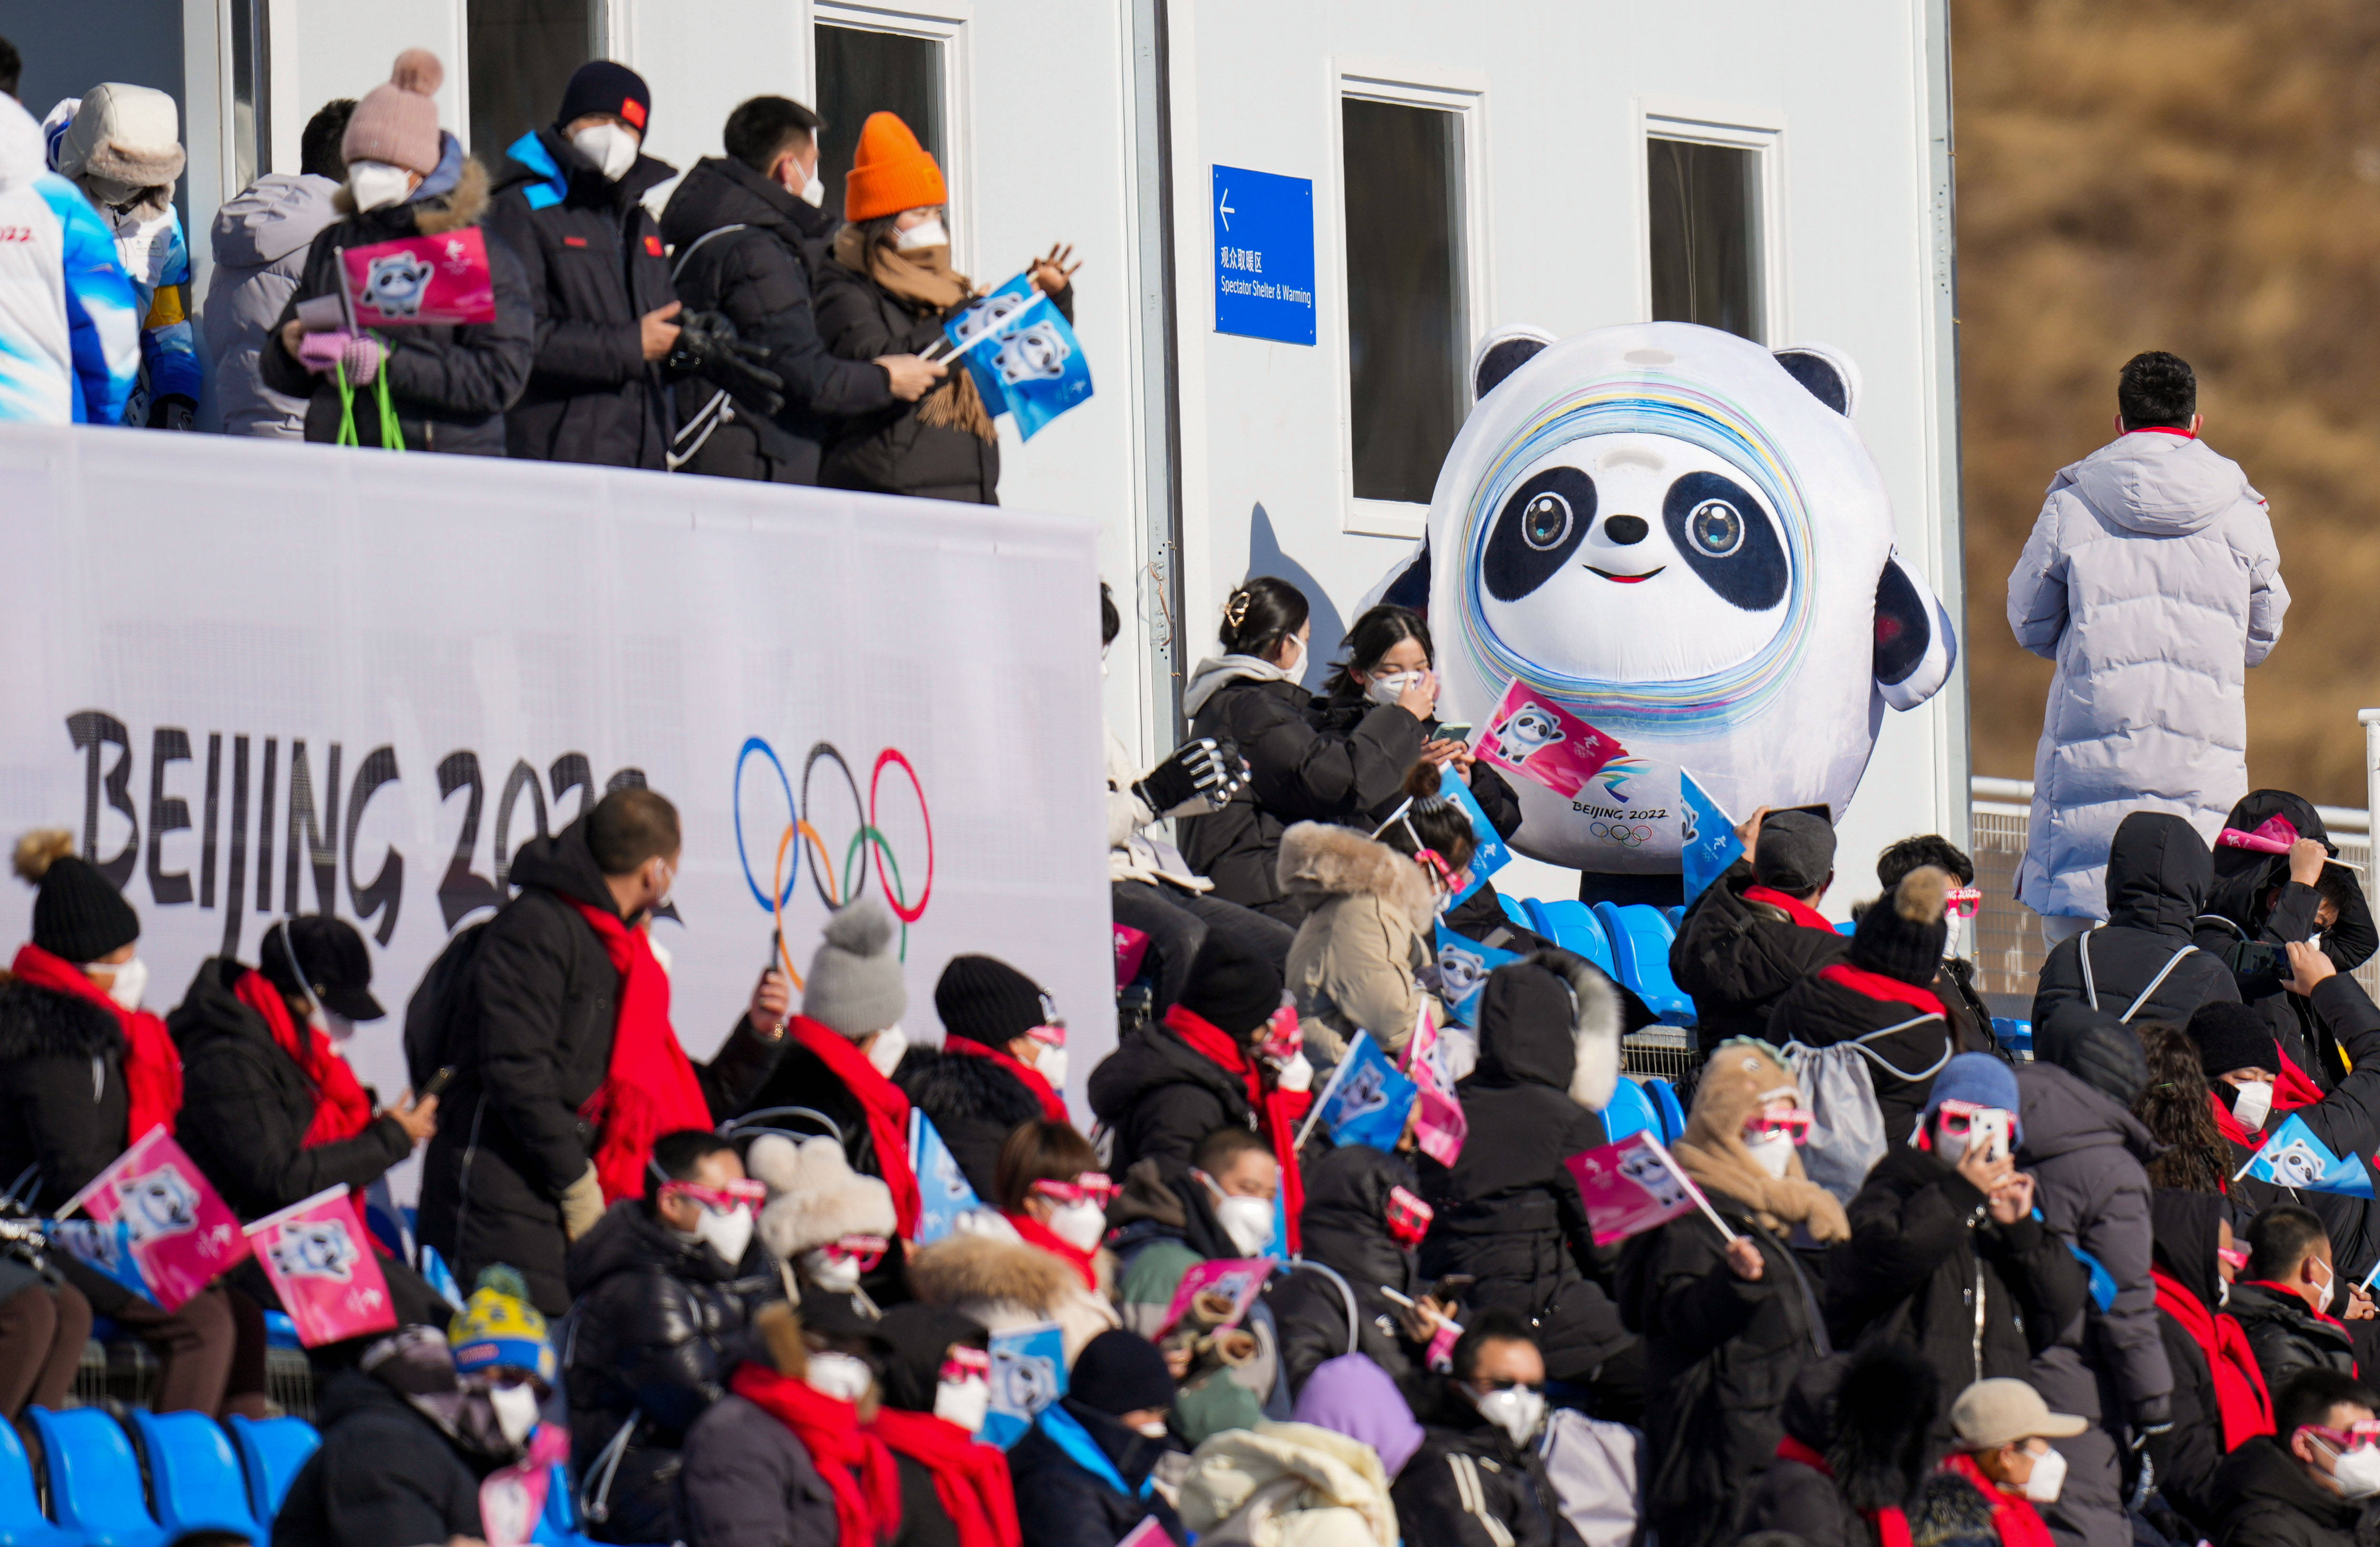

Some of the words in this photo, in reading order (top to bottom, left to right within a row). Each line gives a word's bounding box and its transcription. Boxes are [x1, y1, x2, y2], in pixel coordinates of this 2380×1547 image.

[1221, 246, 1262, 273] 观众取暖区
[1221, 275, 1251, 296] Spectator
[1252, 279, 1275, 299] Shelter
[1276, 283, 1281, 300] &
[1282, 284, 1311, 308] Warming
[1573, 801, 1623, 820] BEIJING
[1629, 809, 1669, 820] 2022
[65, 709, 404, 958] BEIJING
